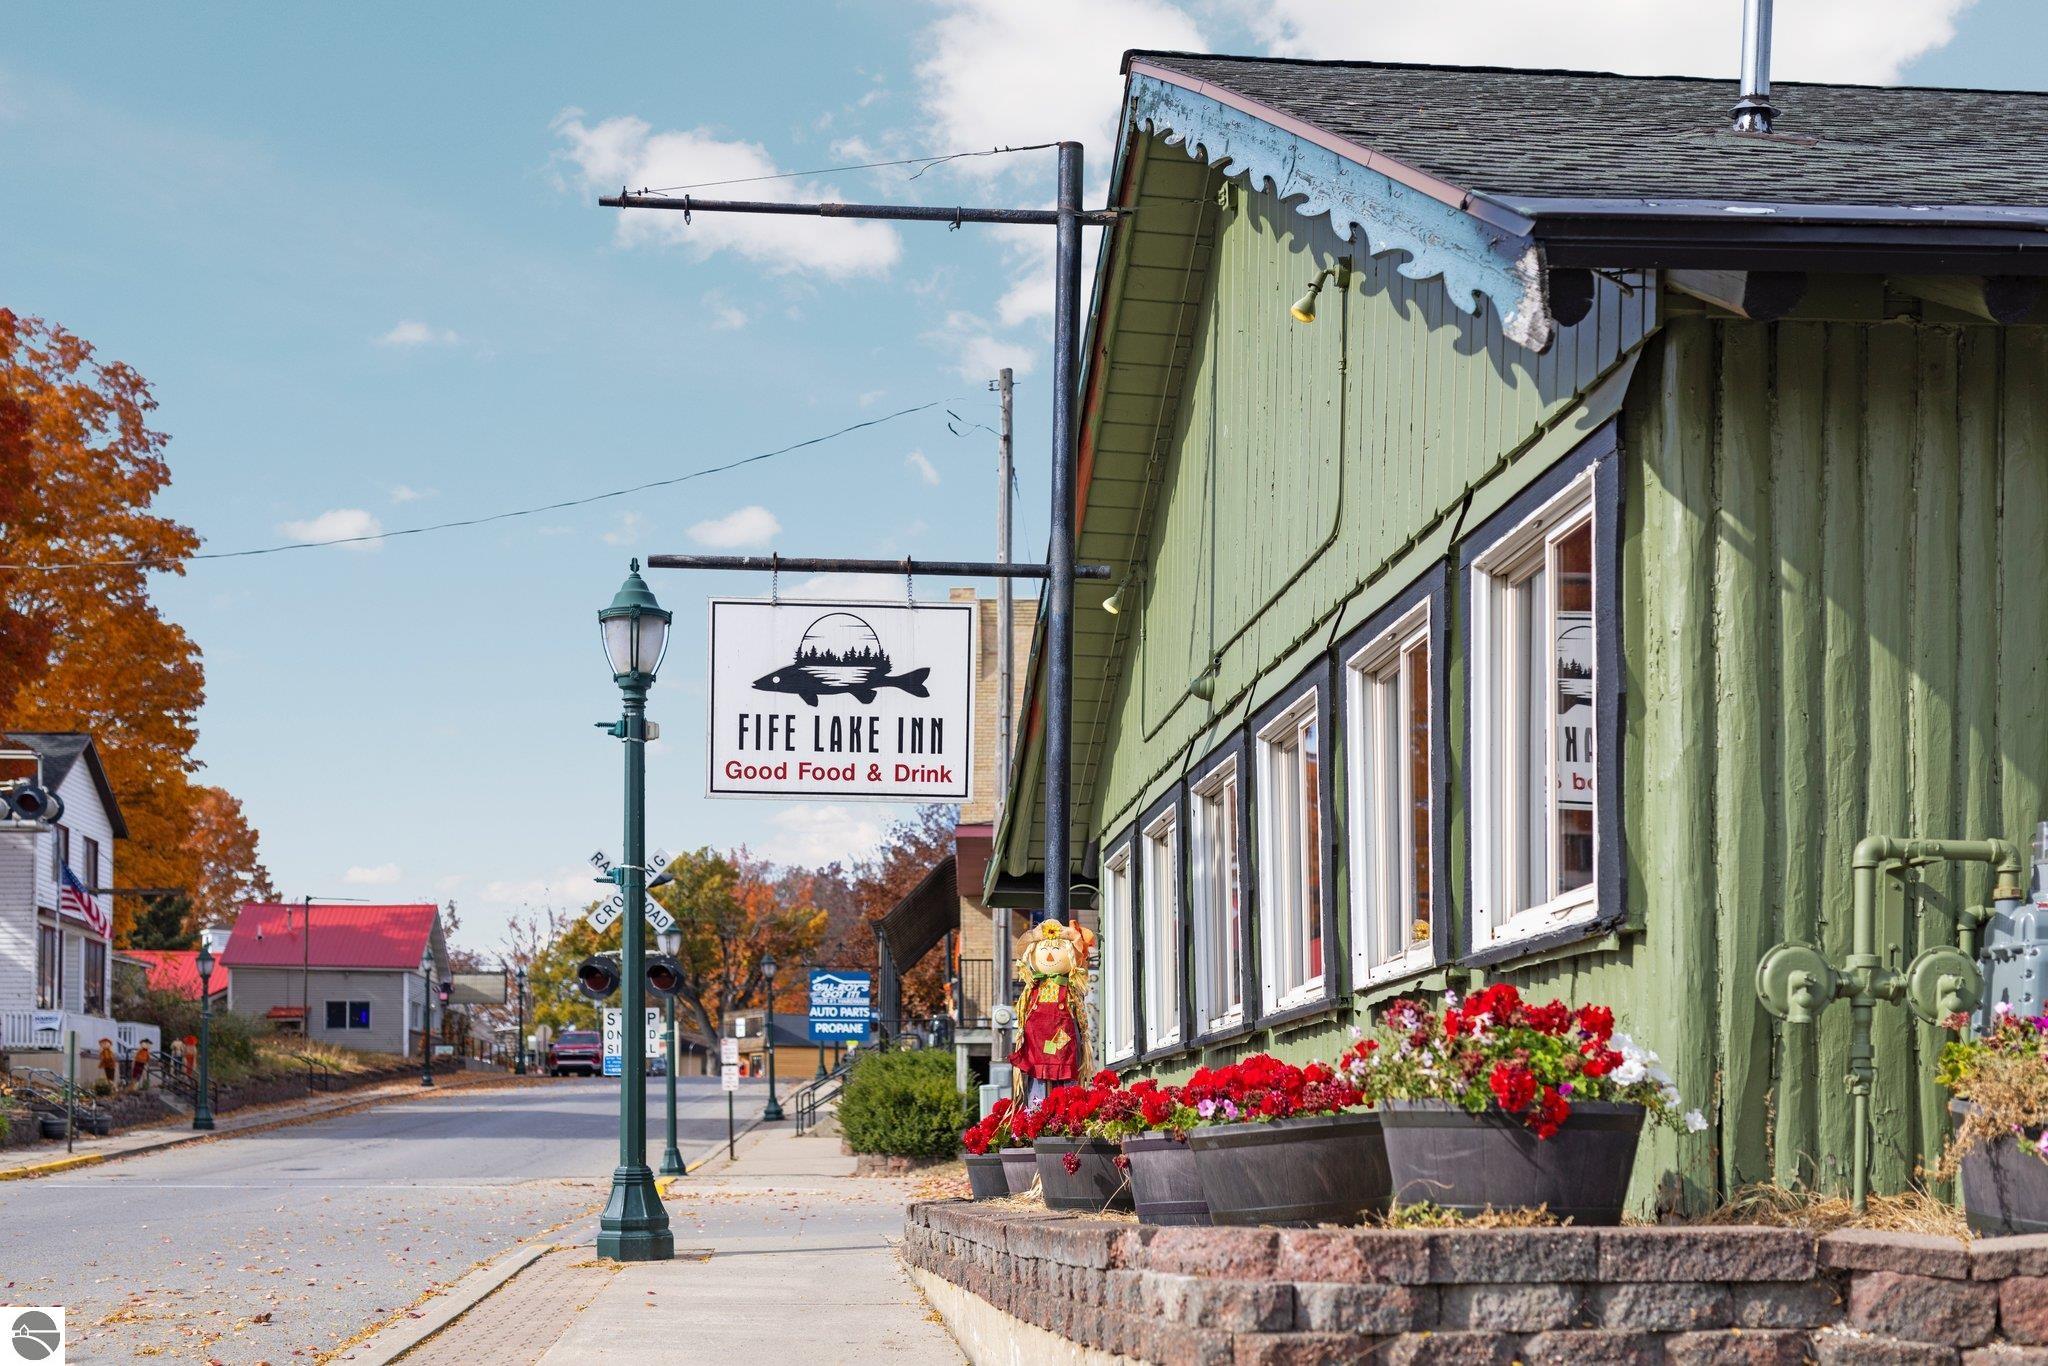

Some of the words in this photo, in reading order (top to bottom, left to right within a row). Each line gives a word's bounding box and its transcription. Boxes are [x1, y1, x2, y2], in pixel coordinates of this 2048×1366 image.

[738, 713, 797, 752] FIFE
[814, 715, 880, 753] LAKE
[897, 716, 944, 755] INN
[725, 760, 788, 781] Good
[798, 761, 856, 782] Food
[866, 763, 883, 782] &
[895, 763, 953, 783] Drink
[591, 852, 669, 928] RAOAD
[595, 855, 666, 925] CRONG
[607, 1012, 657, 1026] SP
[809, 1006, 839, 1017] AUTO
[840, 1006, 870, 1017] PARTS
[815, 1023, 864, 1033] PROPANE
[607, 1044, 656, 1054] SIL
